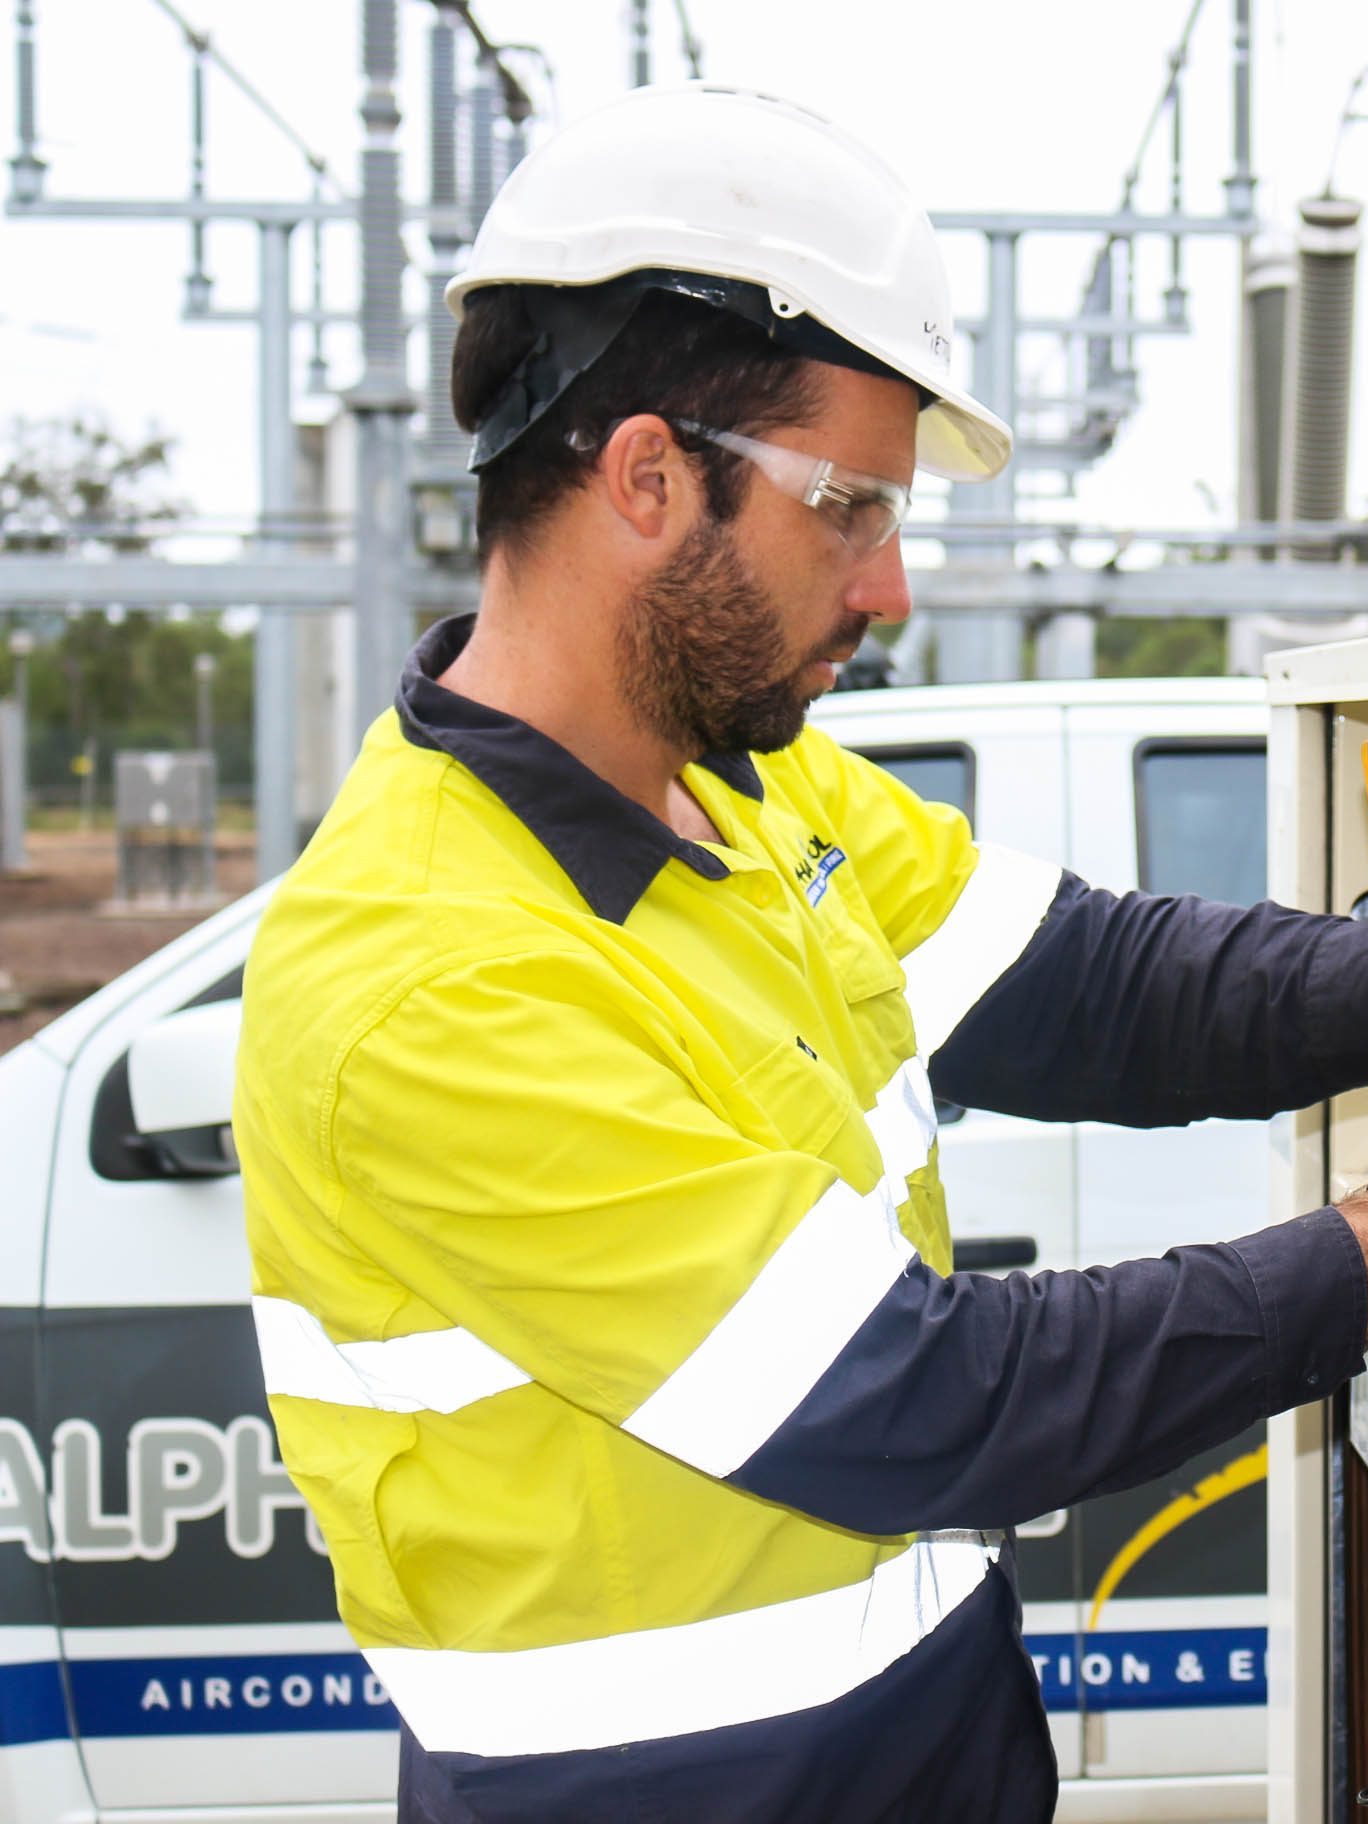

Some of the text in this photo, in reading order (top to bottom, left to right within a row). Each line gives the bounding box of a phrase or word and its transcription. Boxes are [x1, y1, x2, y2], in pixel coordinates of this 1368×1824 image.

[1175, 1650, 1205, 1684] &
[1229, 1649, 1268, 1682] E
[141, 1673, 393, 1711] AIRCOND
